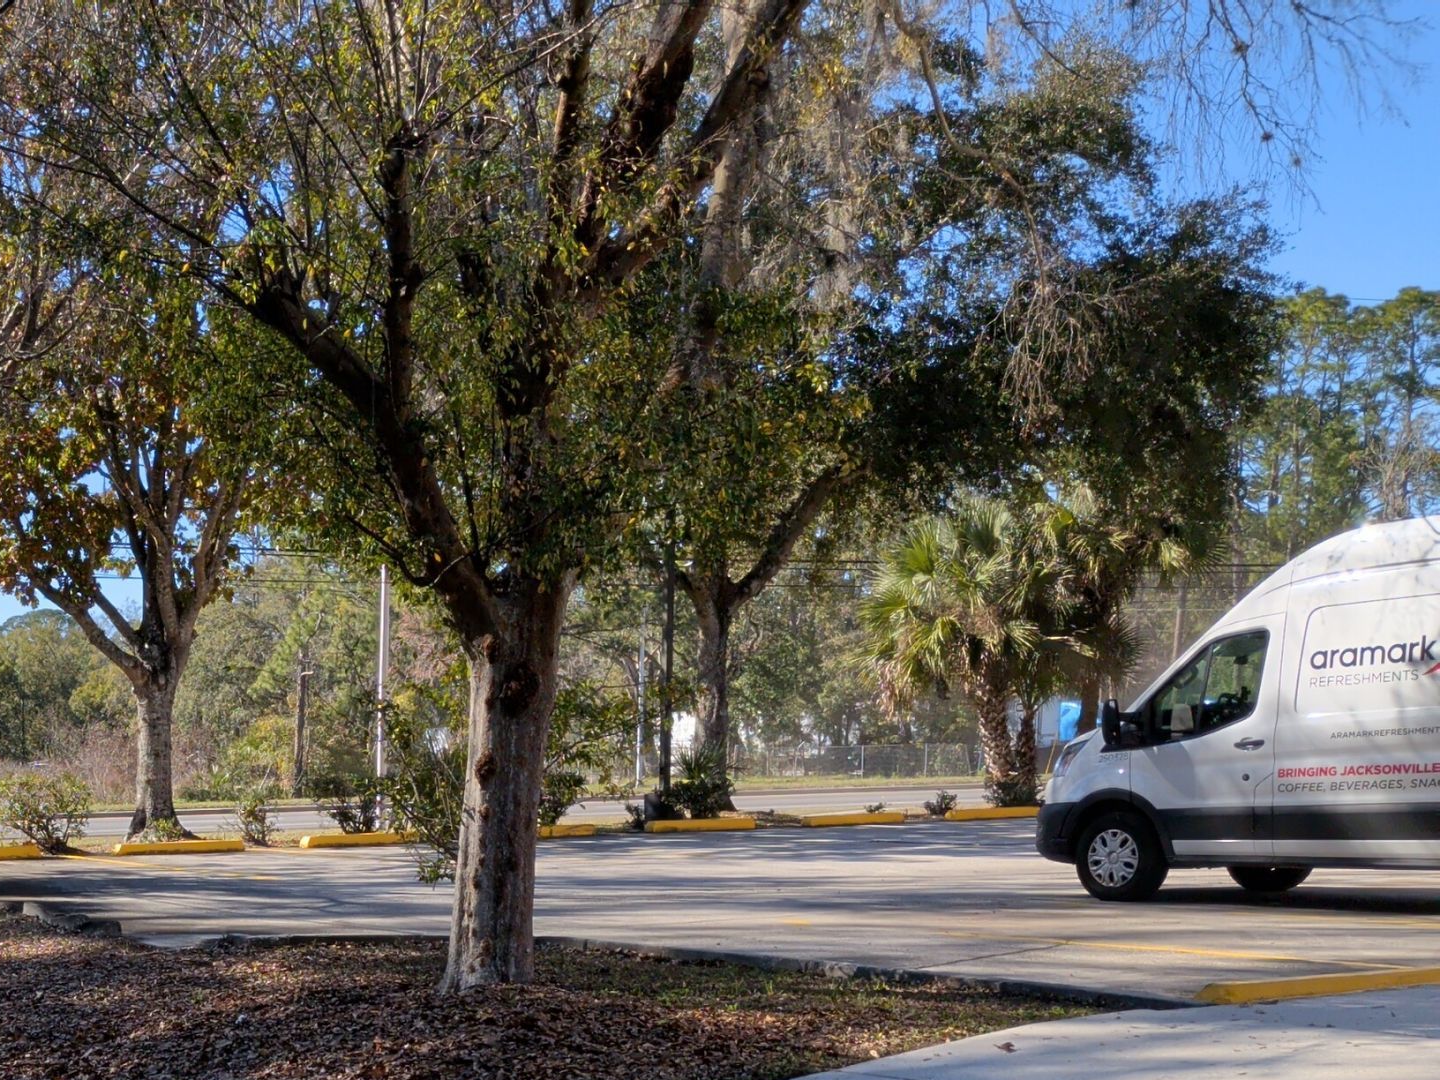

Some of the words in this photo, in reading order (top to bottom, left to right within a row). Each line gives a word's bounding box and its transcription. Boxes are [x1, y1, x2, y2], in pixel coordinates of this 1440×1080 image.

[1310, 635, 1437, 669] aramark
[1309, 669, 1419, 688] REFRESHMENTS
[1277, 766, 1337, 778] BRINGING
[1340, 763, 1440, 776] JACKSONVILLE
[1277, 782, 1326, 793] COFFEE,
[1330, 779, 1406, 791] BEVERAGES,
